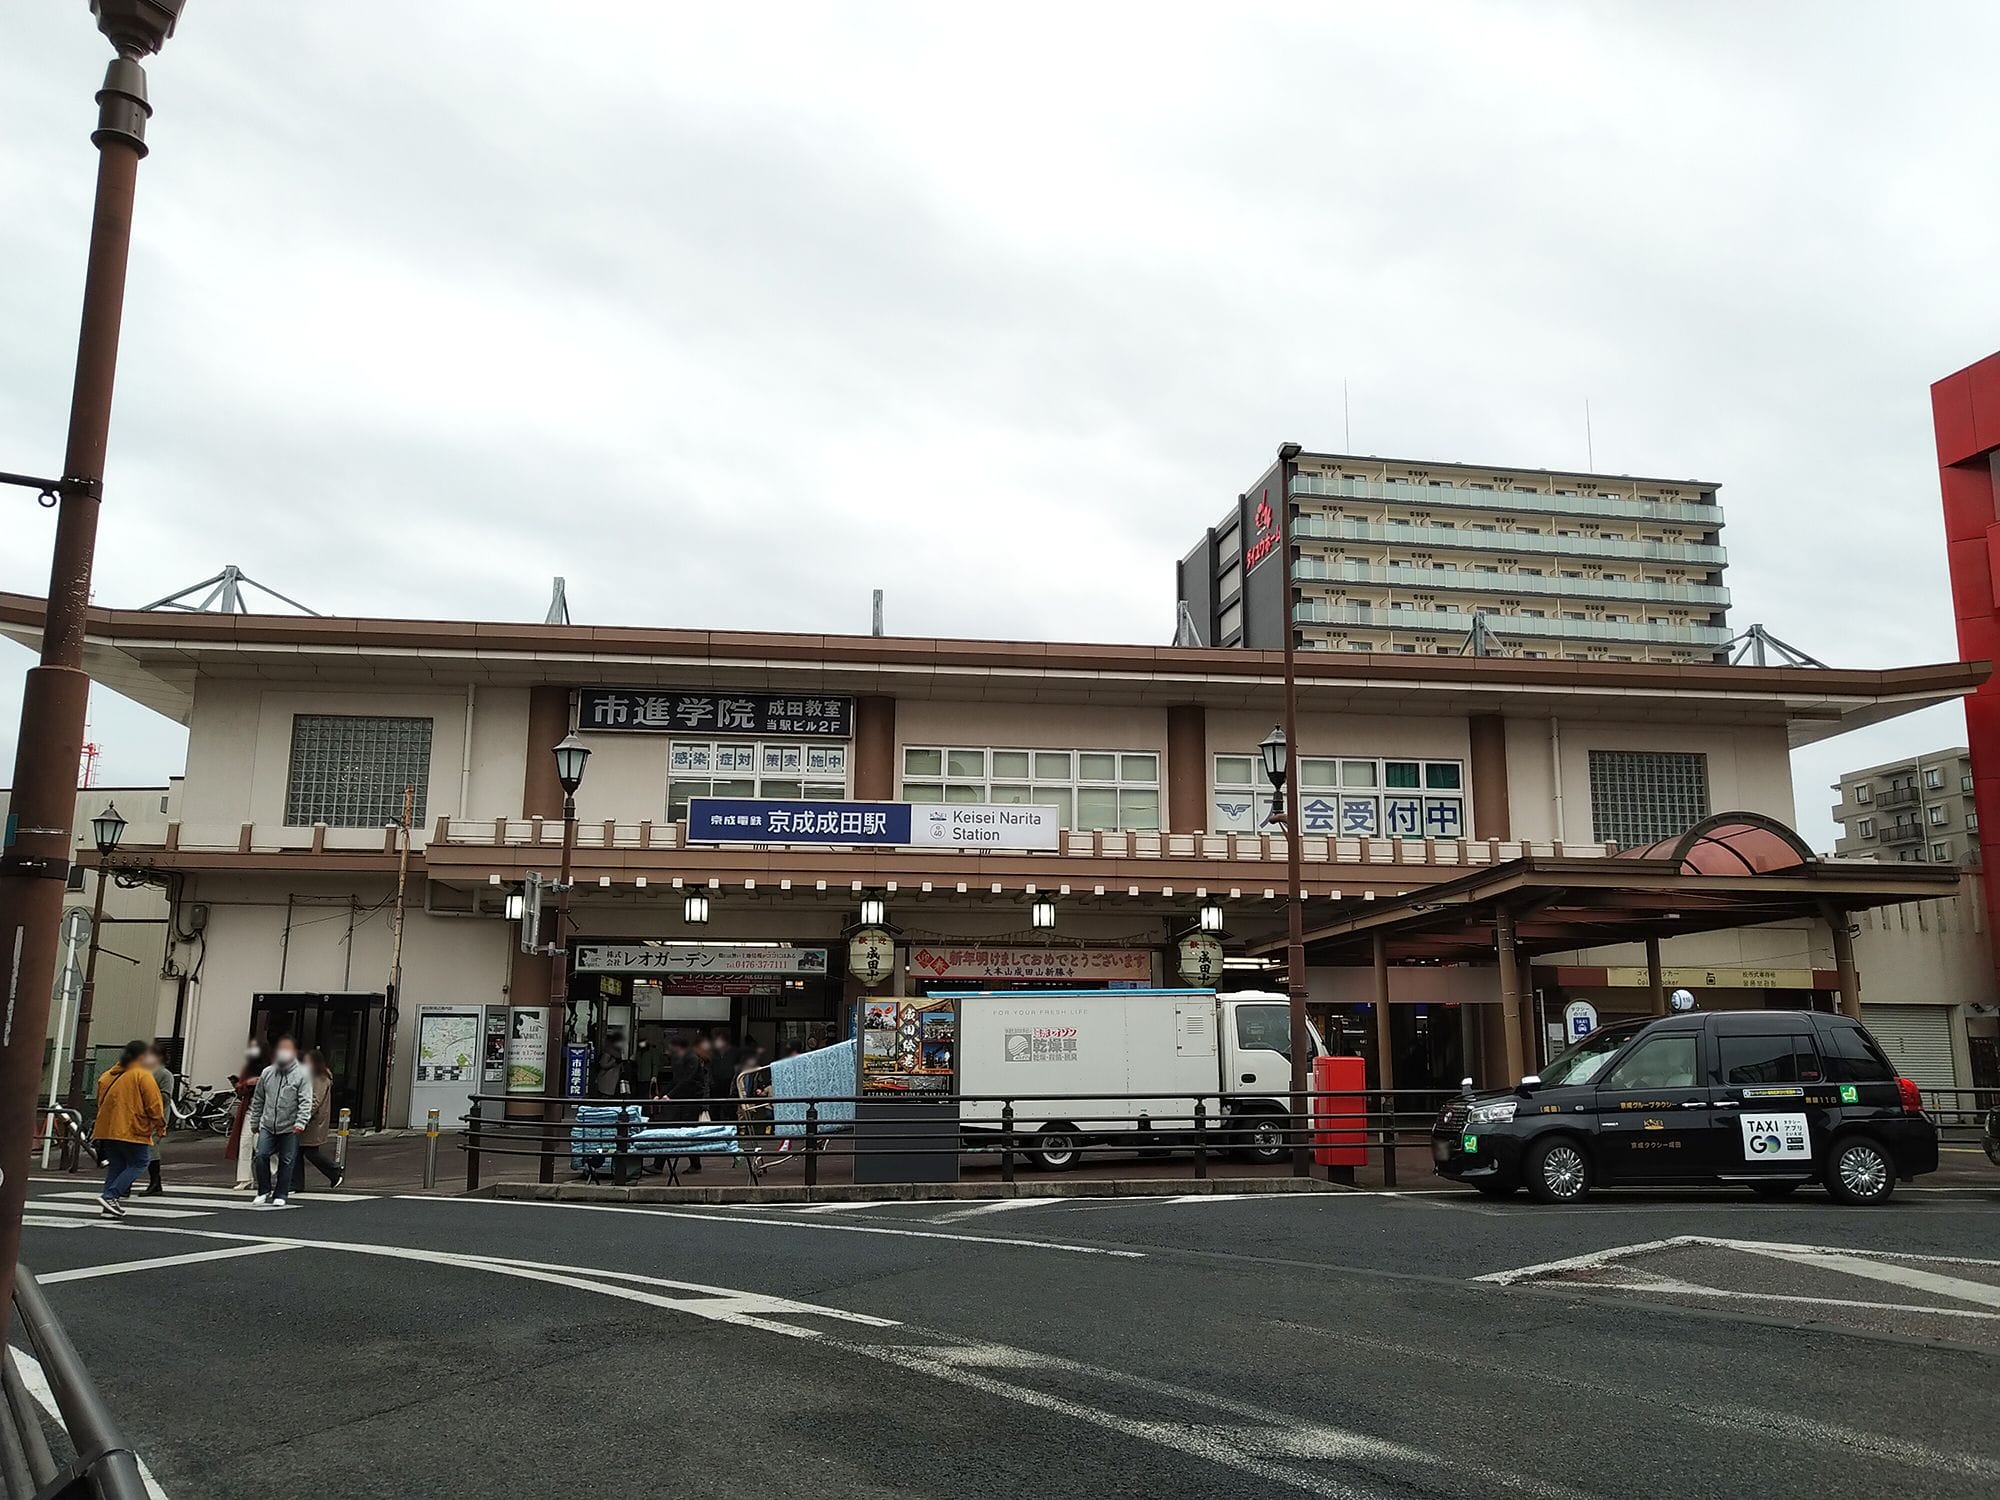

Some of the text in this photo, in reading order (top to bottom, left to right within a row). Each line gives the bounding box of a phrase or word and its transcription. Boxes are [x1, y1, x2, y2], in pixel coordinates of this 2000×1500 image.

[593, 694, 756, 729] 市進学院
[767, 699, 841, 718] 成田教室
[766, 719, 840, 733] 当駅ビル2F
[710, 810, 887, 836] 京成電鉄 京成成田駅
[953, 810, 1042, 826] Keisei Narita
[952, 827, 1001, 842] Station
[624, 951, 716, 968] レオガーデン
[866, 946, 881, 981] 成田山
[949, 950, 1147, 968] 新年明けましておめでとうございます
[1198, 950, 1212, 985] 成田山
[984, 966, 1076, 977] 大本山成田山新勝寺
[1033, 1038, 1078, 1053] 乾燥車
[570, 1058, 582, 1095] 市進学院
[1747, 1120, 1779, 1133] TAXI
